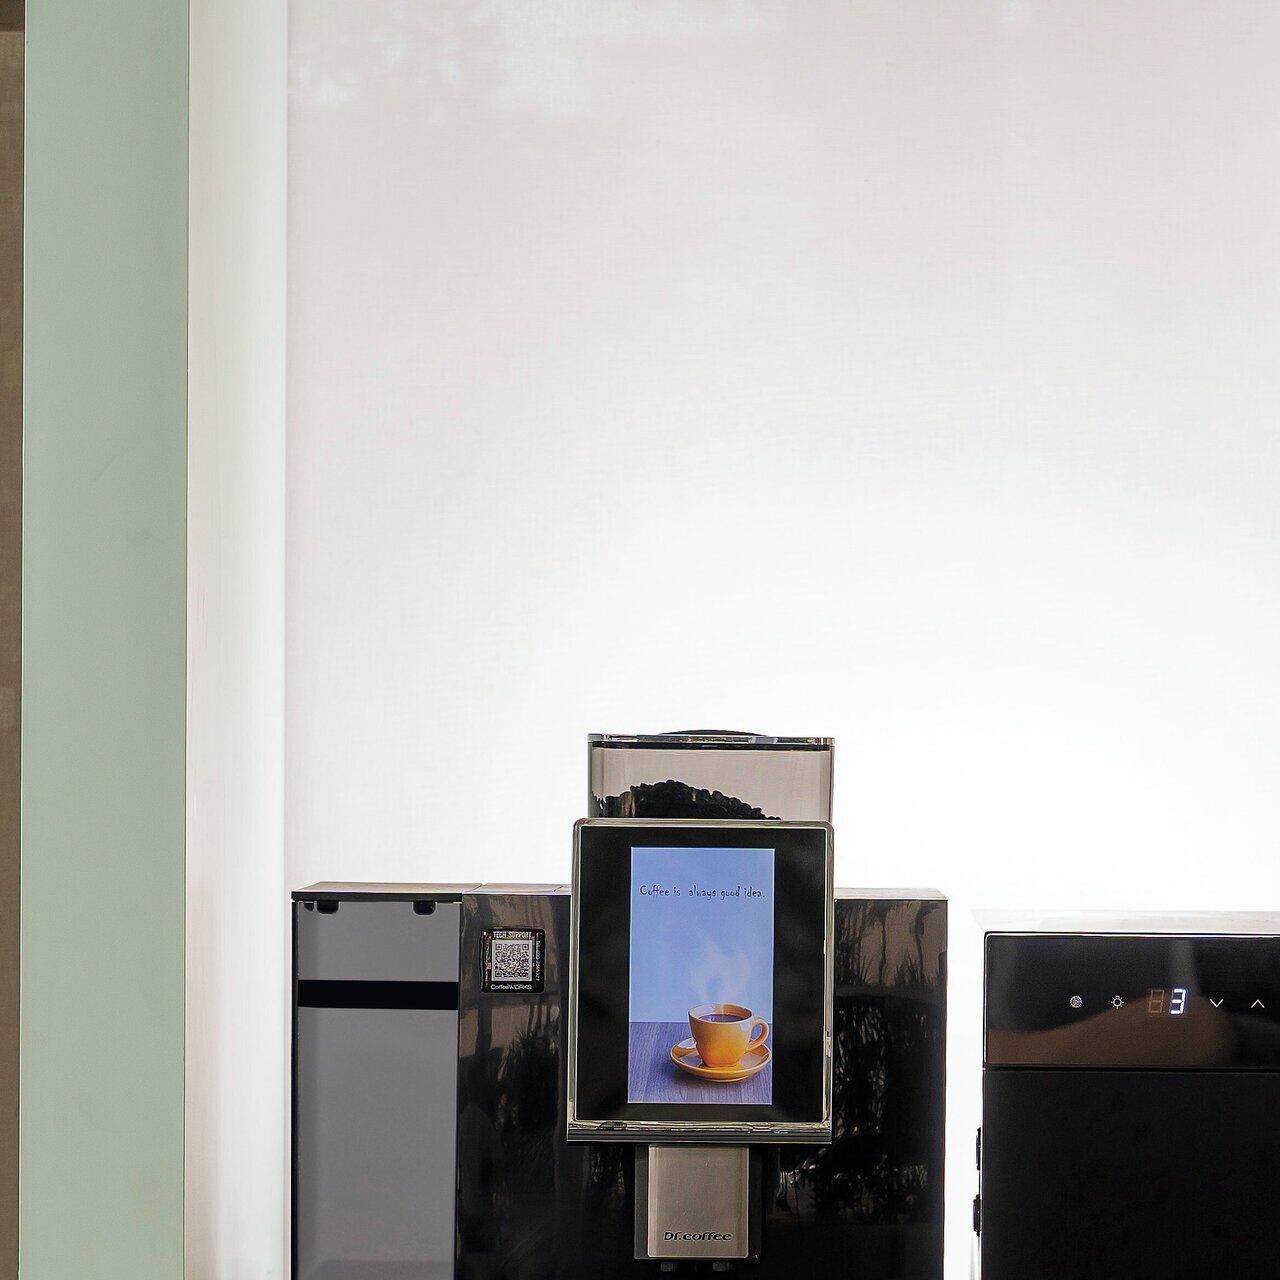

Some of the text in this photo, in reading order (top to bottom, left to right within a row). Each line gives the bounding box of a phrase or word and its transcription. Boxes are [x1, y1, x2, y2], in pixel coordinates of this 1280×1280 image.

[640, 885, 765, 900] Coffee is always good idea.
[1170, 988, 1186, 1014] 3
[664, 1232, 732, 1240] Dr.coffee
